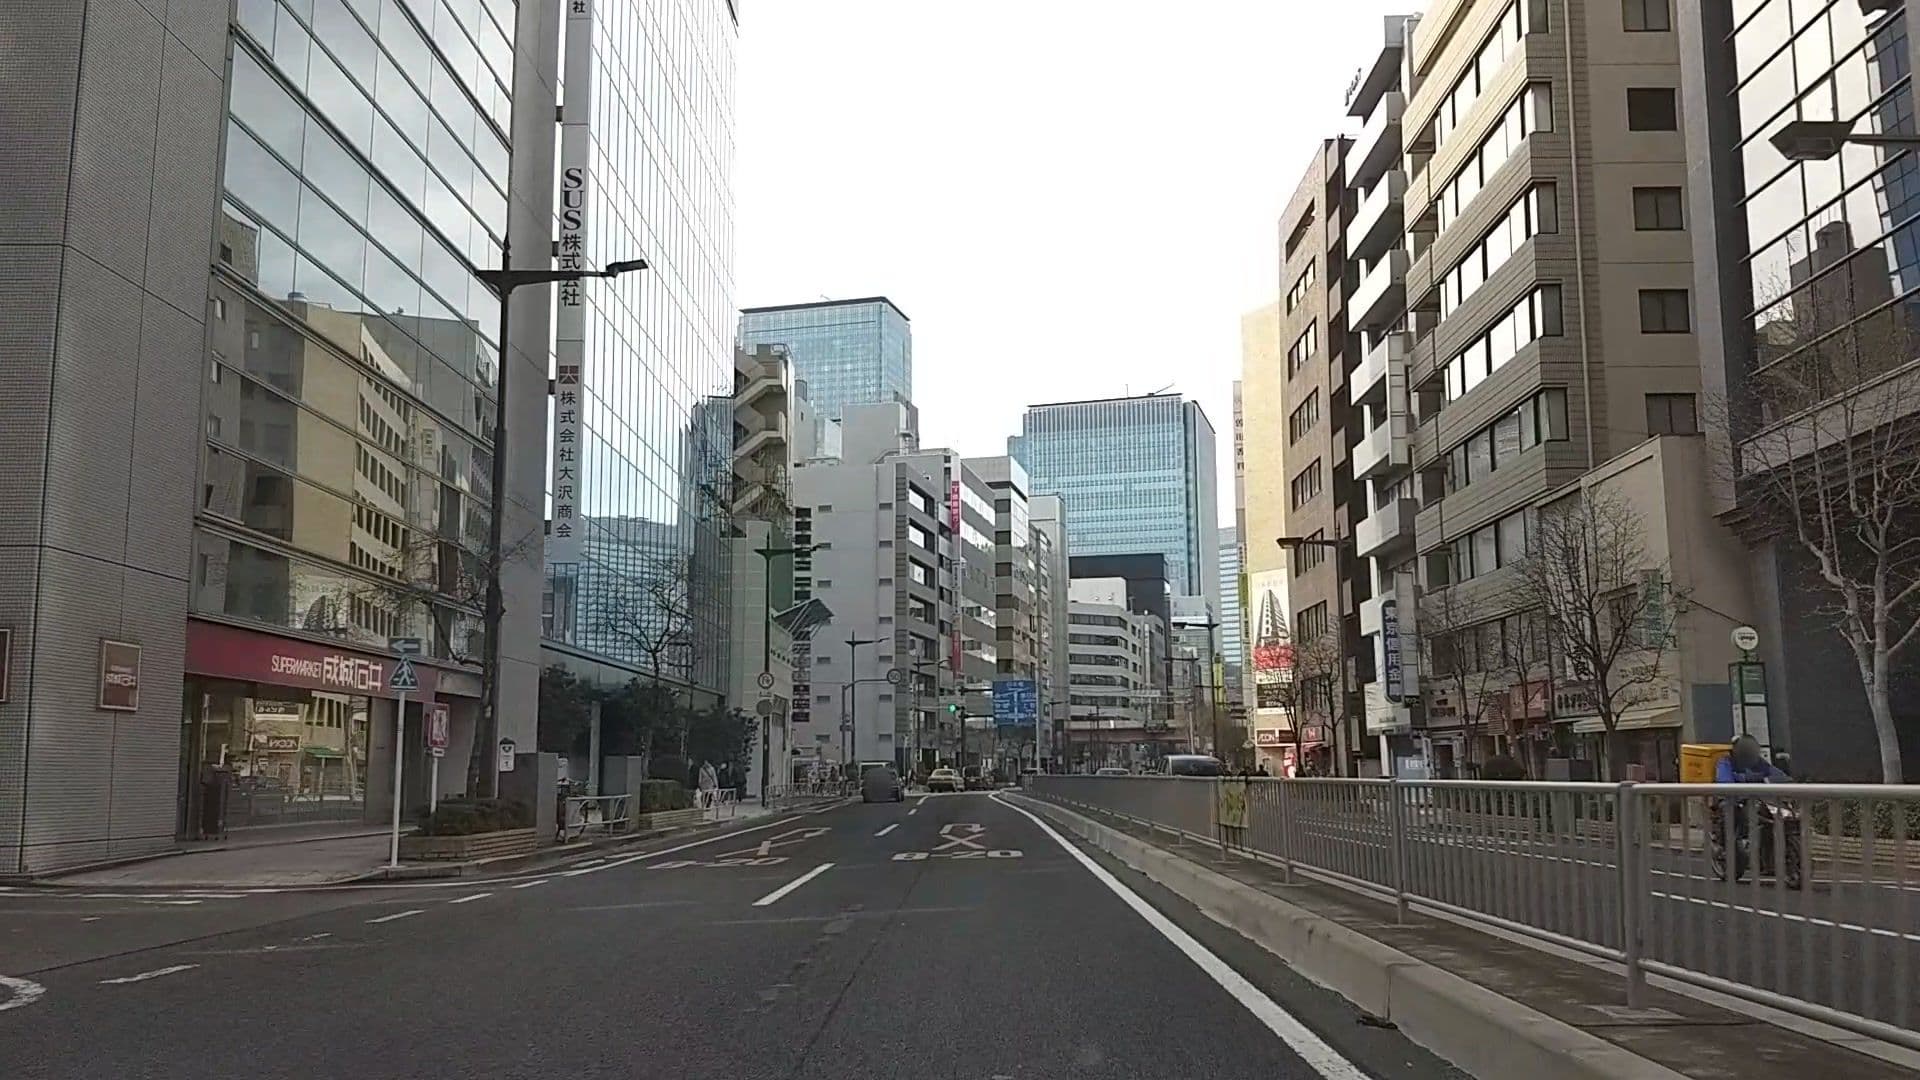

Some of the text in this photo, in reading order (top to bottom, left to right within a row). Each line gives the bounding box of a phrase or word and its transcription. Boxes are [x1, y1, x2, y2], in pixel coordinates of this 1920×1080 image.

[556, 390, 577, 538] 株式会社大沢商会
[271, 654, 383, 692] SUPERMARKET 成城石井
